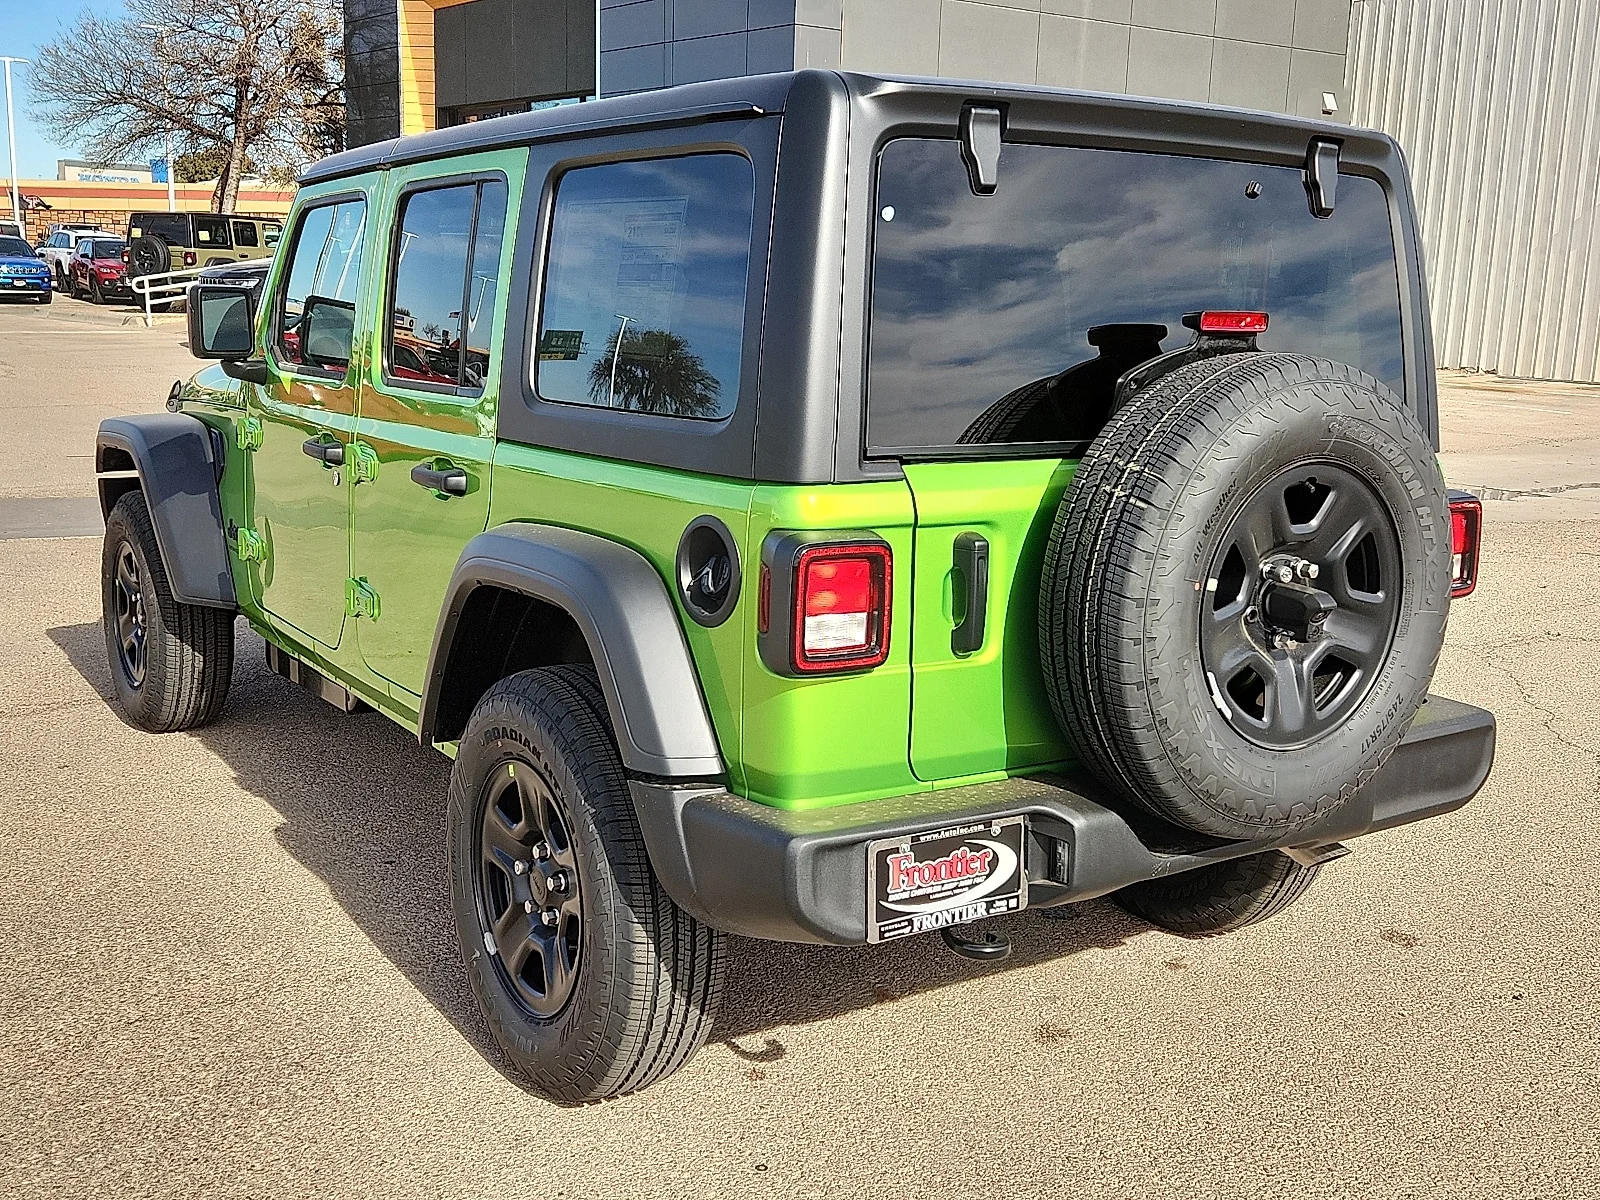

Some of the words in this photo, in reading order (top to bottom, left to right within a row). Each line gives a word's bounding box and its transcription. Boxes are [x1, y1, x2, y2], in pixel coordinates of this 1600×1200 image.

[1192, 538, 1204, 565] All
[1202, 478, 1241, 537] Weather
[1360, 693, 1404, 755] 245/75R17
[919, 824, 986, 843] www.AutoInc.com
[888, 848, 992, 891] Frontier
[911, 901, 988, 933] FRONTIER
